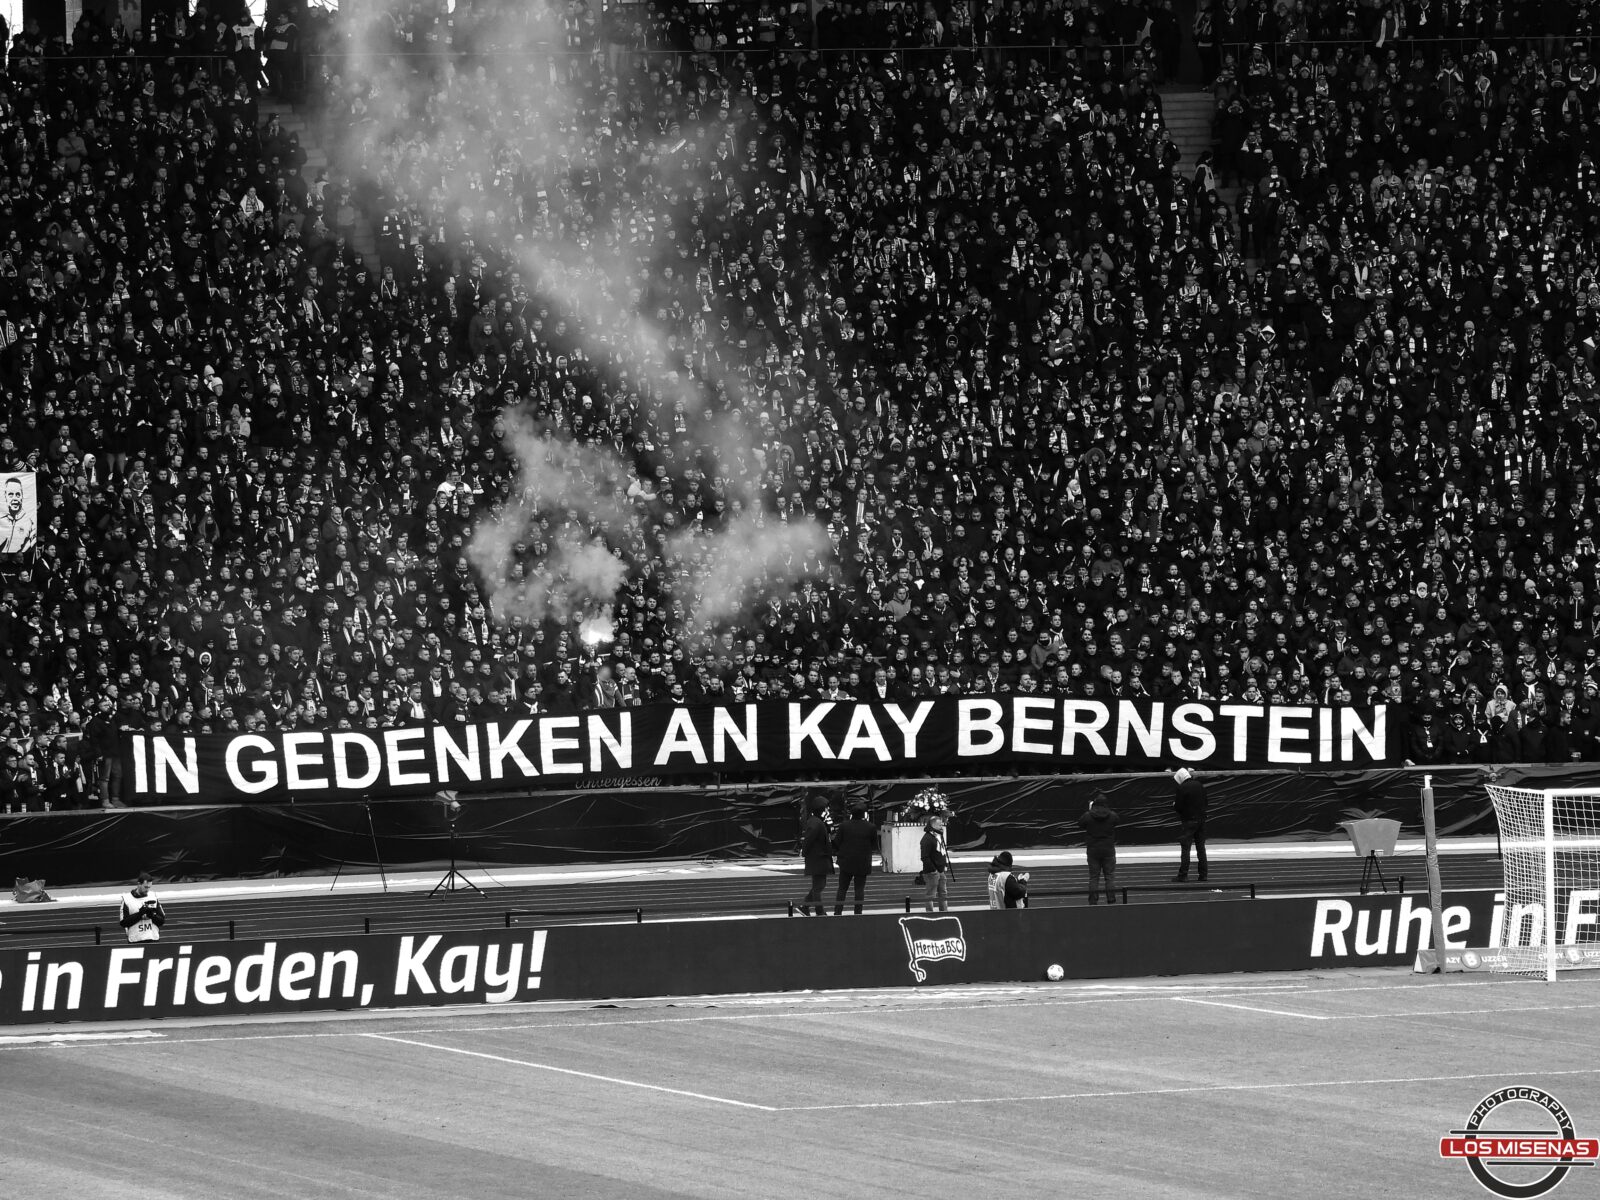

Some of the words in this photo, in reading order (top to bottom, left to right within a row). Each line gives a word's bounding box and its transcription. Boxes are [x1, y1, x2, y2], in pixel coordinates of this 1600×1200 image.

[132, 734, 200, 794] IN
[224, 711, 633, 794] GEDENKEN
[653, 703, 759, 766] AN
[788, 700, 936, 762] KAY
[957, 696, 1387, 764] BERNSTEIN
[138, 923, 153, 932] SM
[1310, 896, 1471, 957] Ruhe
[1489, 892, 1545, 949] in
[21, 951, 84, 1011] in
[103, 942, 375, 1008] Frieden,
[394, 930, 548, 1003] Kay!
